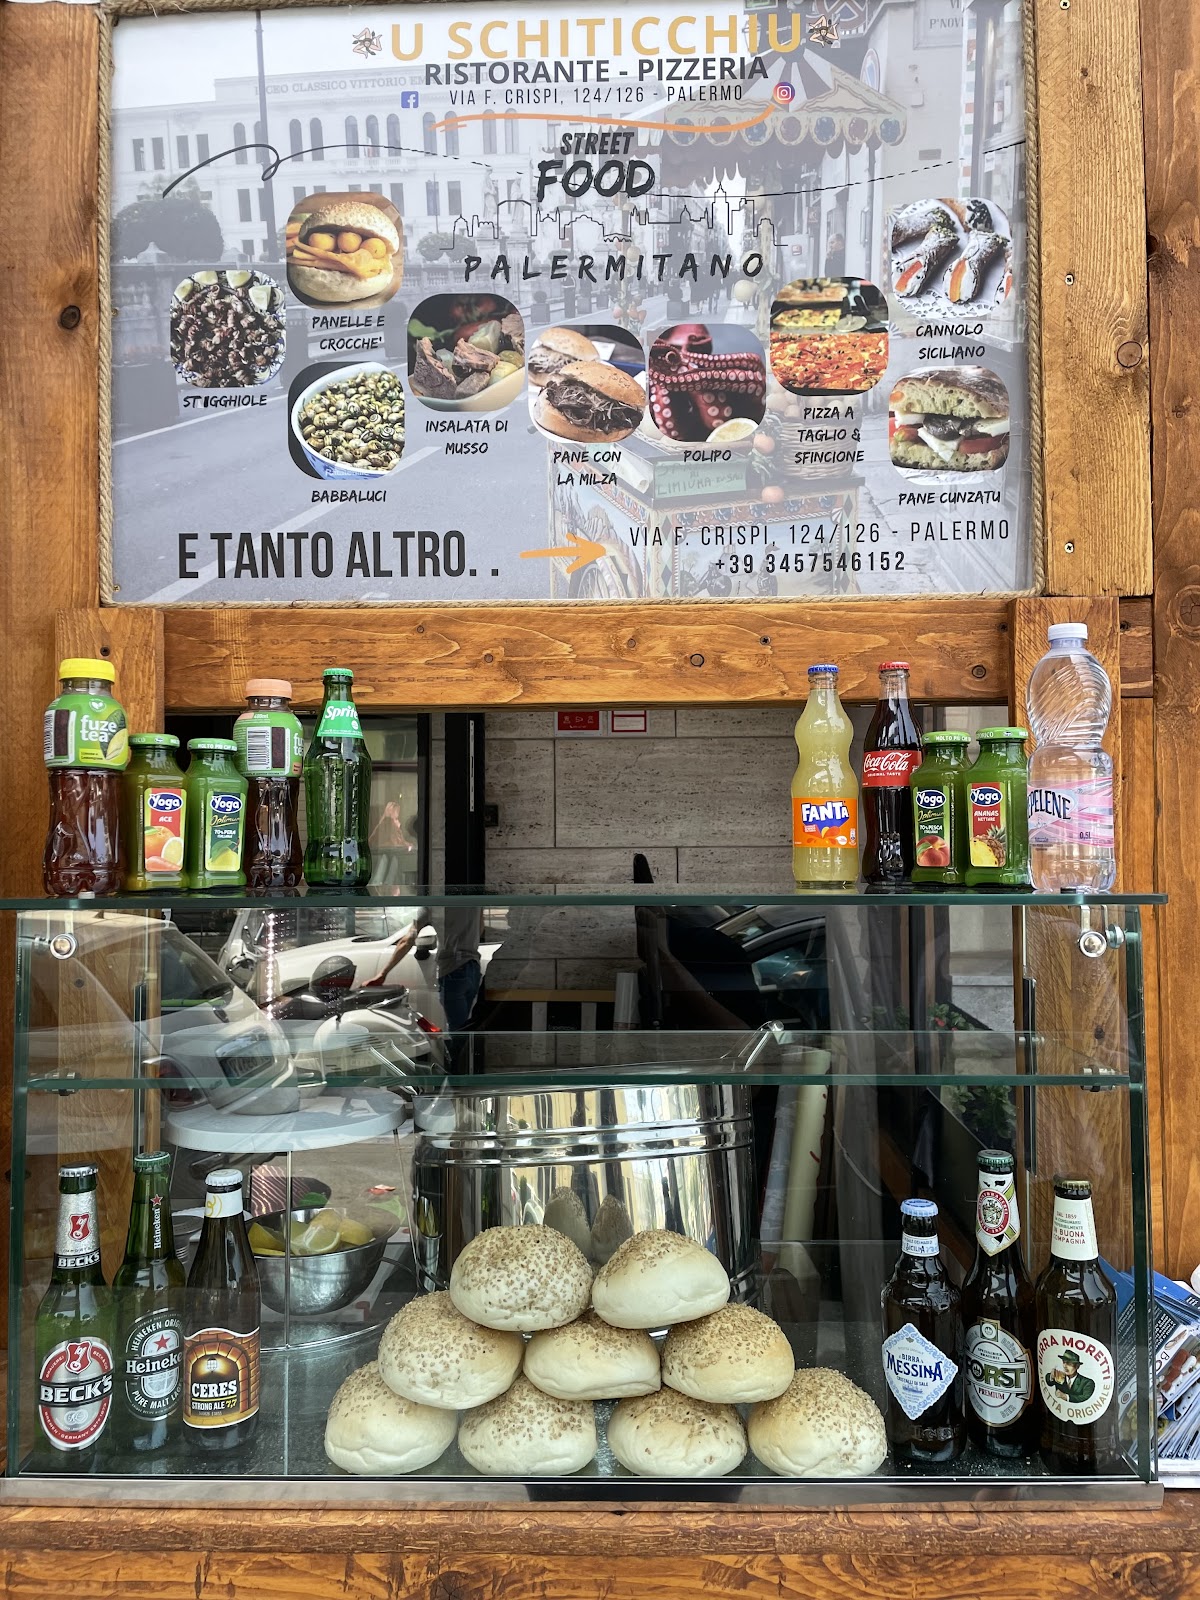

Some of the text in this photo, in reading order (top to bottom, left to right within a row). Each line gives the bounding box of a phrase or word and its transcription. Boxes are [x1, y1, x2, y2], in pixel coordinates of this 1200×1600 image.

[391, 13, 800, 61] U SCHITICCHIU
[425, 58, 609, 85] RISTORANTE
[638, 56, 768, 83] PIZZERIA
[291, 79, 348, 94] CLASSICO
[349, 77, 407, 90] VITTORIO
[449, 89, 475, 105] VIA
[485, 88, 497, 104] F.
[505, 87, 565, 106] CRISPI,
[573, 85, 645, 103] 124/126
[667, 84, 743, 102] PALERMO
[560, 131, 635, 155] STREET
[537, 159, 655, 203] FOOD
[464, 252, 764, 284] PALERMITANO
[312, 315, 385, 329] PANELLE E
[915, 323, 984, 338] CANNOLO
[319, 336, 383, 351] CROCCHE'
[918, 345, 986, 360] SICILIANO
[803, 406, 854, 420] PIZZA A
[425, 419, 508, 434] INSALATA DI
[797, 428, 861, 442] TAGLIO &
[445, 441, 489, 455] MUSSO
[683, 449, 732, 463] POLIPO
[553, 451, 621, 464] PANE CON
[794, 450, 865, 464] SFINCIONE
[557, 472, 618, 486] LA MILZA
[311, 489, 387, 503] BABBALUCI
[898, 490, 1001, 506] PANE CUNZATU
[629, 526, 664, 547] VIA
[674, 526, 690, 546] F.
[700, 525, 777, 548] CRISPI,
[789, 522, 881, 545] 124/126
[911, 519, 1010, 542] PALERMO
[177, 532, 199, 579] E
[210, 531, 334, 579] TANTO
[715, 551, 906, 575] +39 3457546152
[324, 704, 359, 721] Sprite
[80, 714, 117, 733] fuze
[80, 728, 108, 743] tea
[151, 793, 180, 810] Yoga
[212, 796, 240, 812] Yoga
[917, 791, 943, 807] Yoga
[971, 789, 999, 805] Yoga
[801, 801, 849, 823] FANTA
[152, 1207, 162, 1250] Heineken
[1059, 1229, 1085, 1238] BUONA
[1053, 1233, 1086, 1245] COMPAGNIA
[58, 1251, 100, 1267] BECK'S
[131, 1321, 162, 1351] HEINEKEN
[126, 1352, 183, 1374] Heineke
[901, 1353, 920, 1363] BIRRA
[1062, 1335, 1111, 1380] MORETTI
[886, 1350, 943, 1382] MESSINA
[40, 1374, 113, 1403] BECK'S
[191, 1379, 238, 1398] CERES
[978, 1387, 1005, 1400] PREMIUM
[131, 1390, 149, 1408] PURE
[150, 1397, 169, 1409] MALT
[191, 1401, 213, 1411] STRONG
[213, 1401, 226, 1410] ALE
[1067, 1384, 1111, 1419] ORIGINALE
